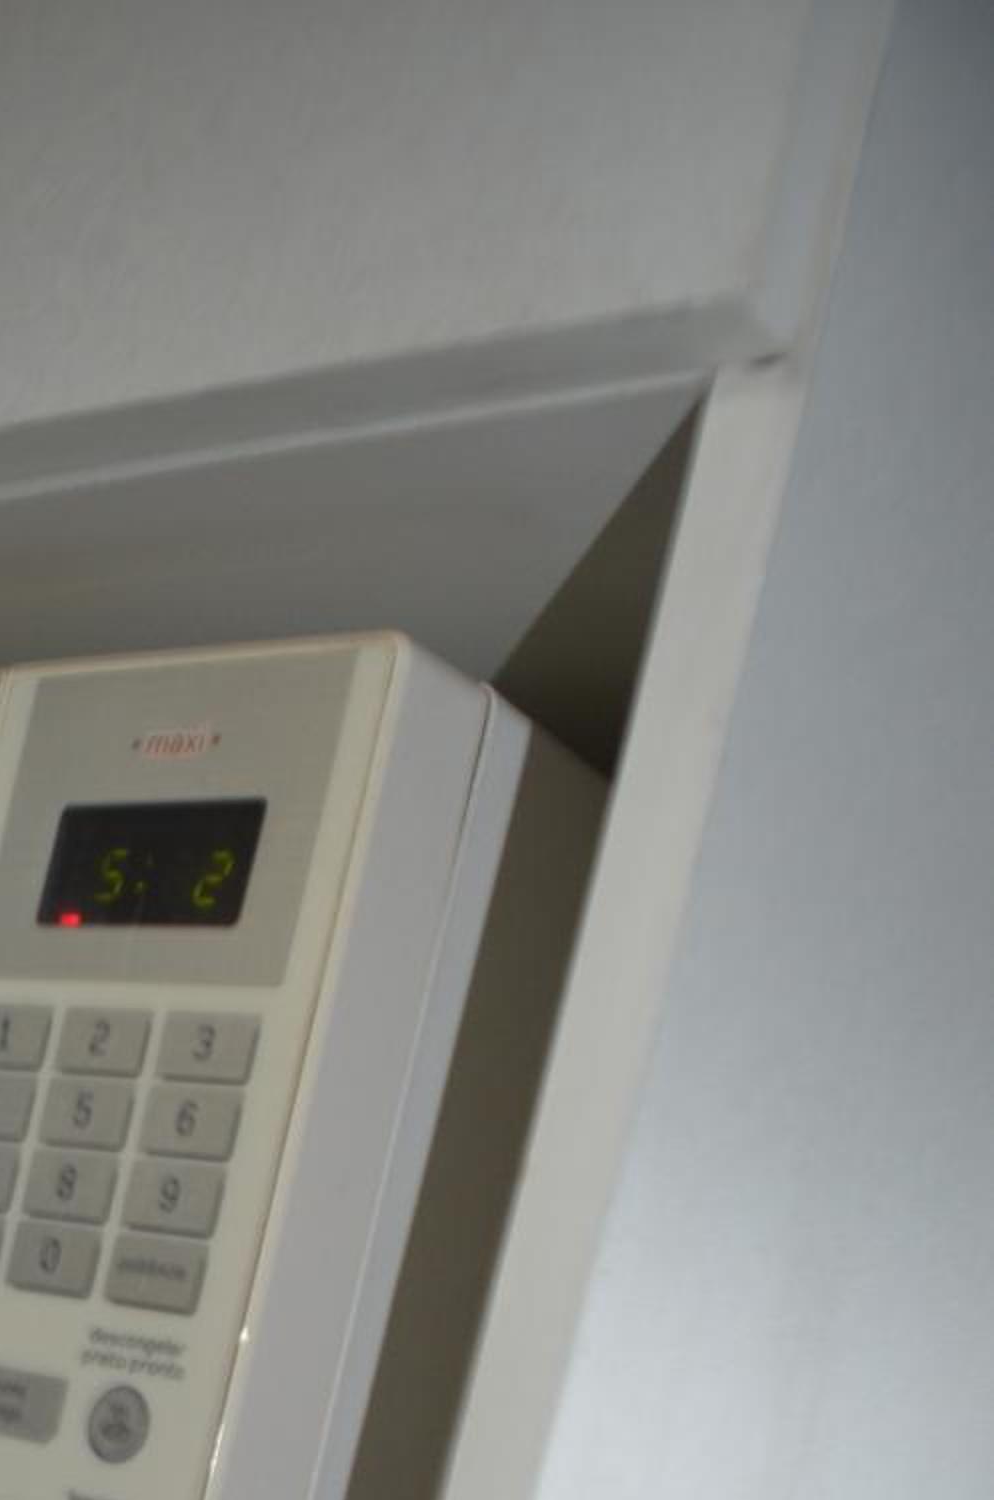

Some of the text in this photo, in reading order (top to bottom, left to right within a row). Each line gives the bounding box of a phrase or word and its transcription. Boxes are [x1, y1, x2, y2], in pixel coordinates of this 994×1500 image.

[143, 732, 207, 755] maxi
[89, 1019, 110, 1057] 2
[192, 1023, 216, 1062] 3
[72, 1089, 95, 1130] 5
[175, 1101, 200, 1137] 6
[56, 1163, 78, 1201] 8
[158, 1176, 181, 1213] 9
[39, 1237, 62, 1273] 0
